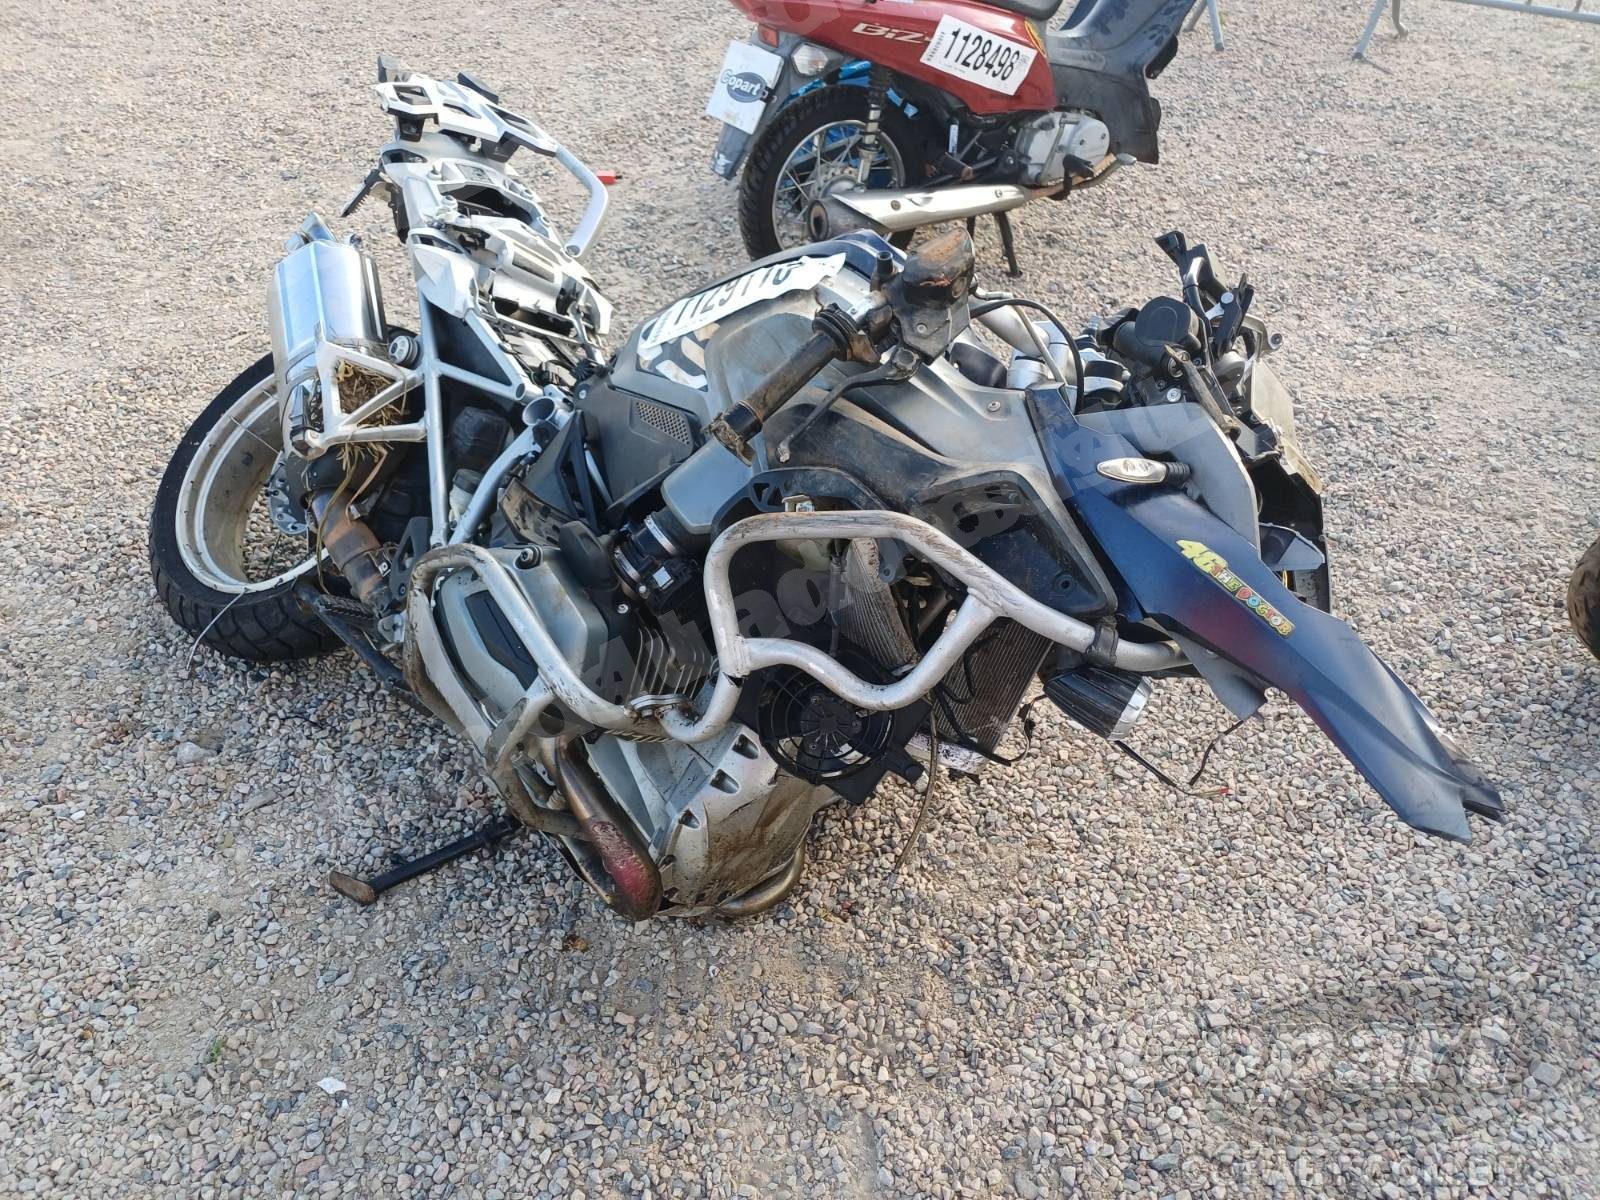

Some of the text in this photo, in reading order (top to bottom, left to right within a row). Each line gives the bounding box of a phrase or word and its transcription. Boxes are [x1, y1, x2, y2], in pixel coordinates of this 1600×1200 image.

[944, 28, 1020, 80] 1128498
[721, 68, 762, 96] Copart
[1176, 539, 1228, 574] 46
[1210, 563, 1293, 636] THE DOCTOR
